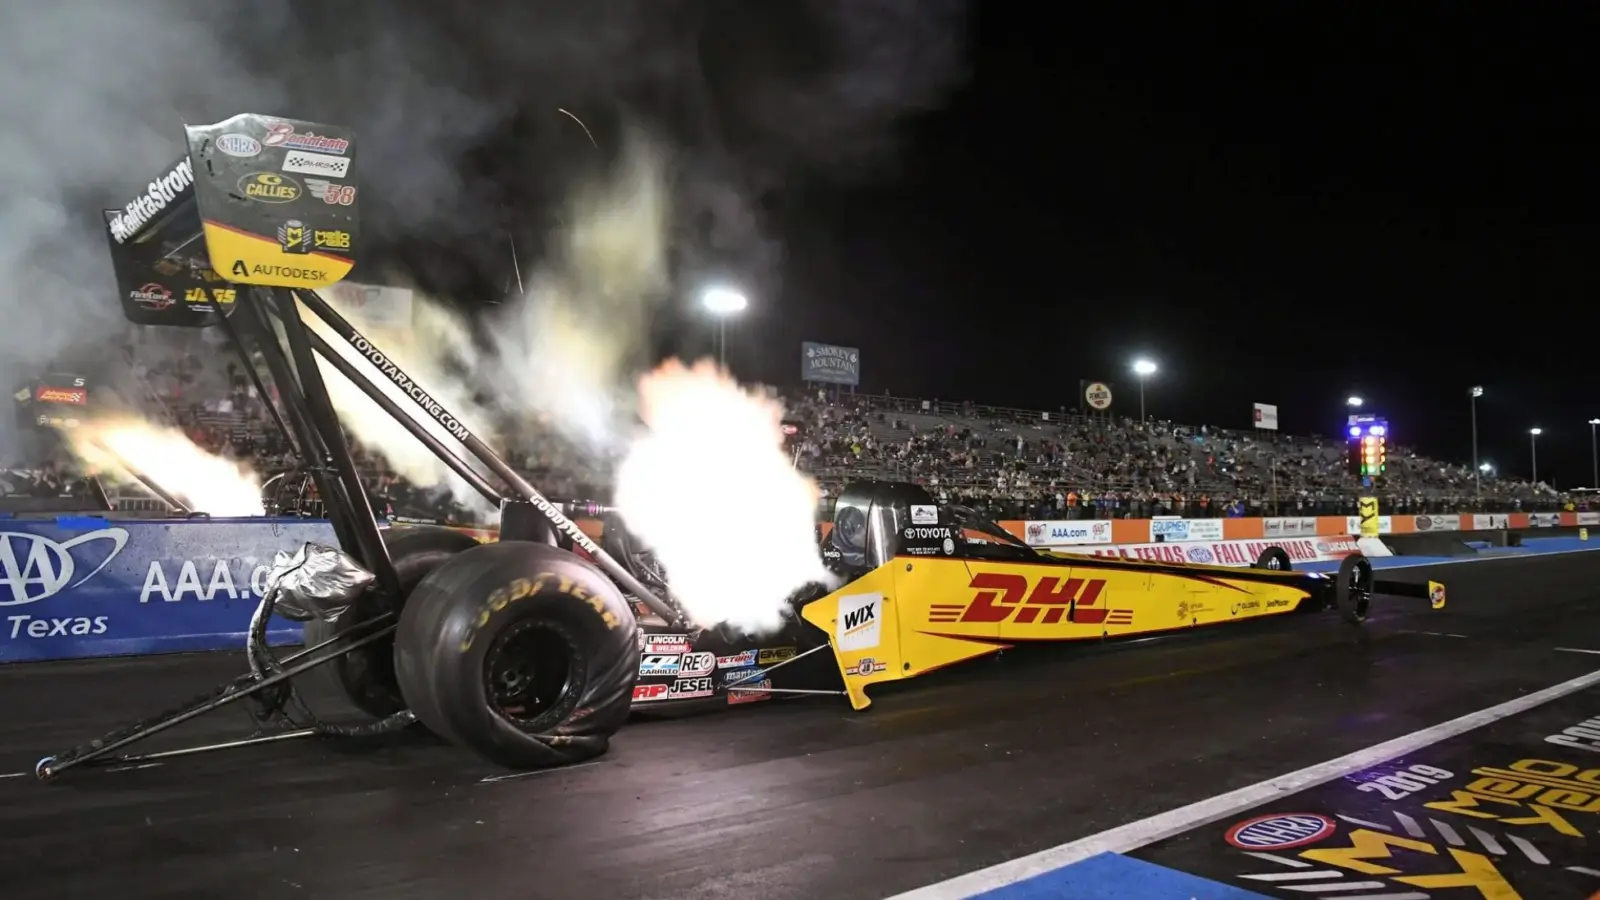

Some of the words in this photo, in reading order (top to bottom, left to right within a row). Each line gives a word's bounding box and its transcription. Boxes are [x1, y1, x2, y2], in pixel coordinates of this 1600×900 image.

[222, 138, 257, 151] NHRA
[246, 183, 296, 199] CALLIES
[323, 184, 355, 205] 58
[253, 264, 328, 281] AUTODESK
[815, 346, 850, 361] SMOKEY
[810, 357, 855, 374] MOUNTAIN
[350, 331, 469, 440] TOYOTARACING.COM
[915, 527, 951, 539] TOYOTA
[1051, 528, 1087, 538] AAA.com
[1133, 545, 1186, 564] TEXAS
[1211, 540, 1248, 564] FALL
[960, 572, 1110, 624] DHL
[844, 602, 875, 630] WIX
[7, 614, 109, 639] Texas
[649, 636, 685, 644] LINCOLN
[670, 679, 712, 693] JESEL
[1357, 764, 1455, 800] 2019
[1240, 816, 1321, 845] NHRA
